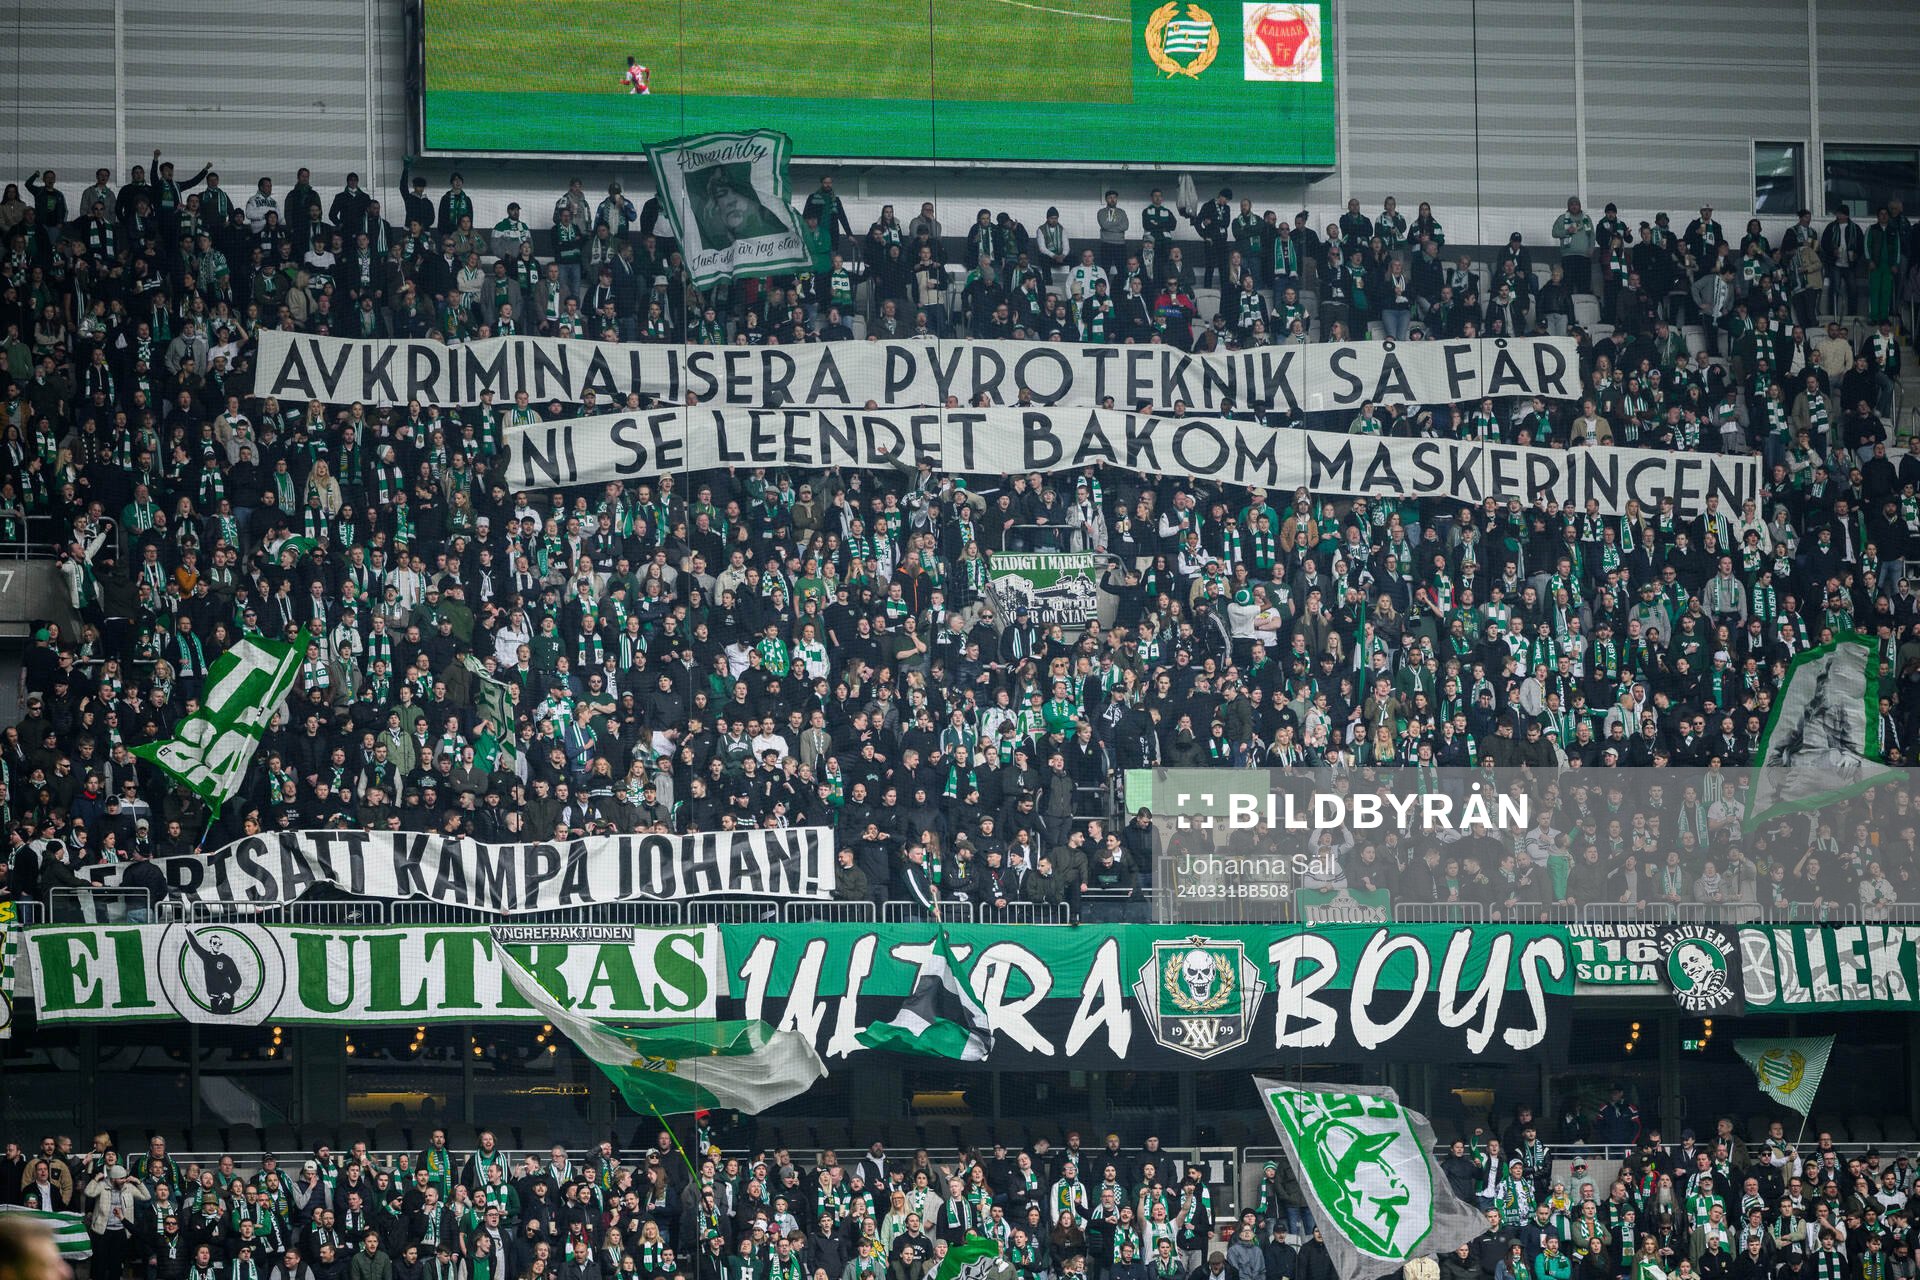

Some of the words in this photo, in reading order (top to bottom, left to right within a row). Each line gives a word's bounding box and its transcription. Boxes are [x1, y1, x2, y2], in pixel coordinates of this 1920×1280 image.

[1261, 24, 1304, 36] KALMAR
[756, 241, 774, 256] jag
[884, 345, 1298, 410] PYROTEKNIK
[1330, 342, 1416, 403] SÅ
[1443, 338, 1566, 399] FÅR
[521, 426, 578, 487] NI
[614, 412, 684, 474] SE
[718, 409, 986, 470] LEENDET
[1023, 409, 1277, 486] BAKOM
[990, 555, 1037, 571] STADIGT
[1040, 556, 1046, 570] I
[1048, 554, 1094, 570] MARKEN
[1042, 610, 1058, 623] OM
[90, 831, 370, 920] FRTSATT
[615, 828, 820, 900] JOHAN!
[494, 926, 632, 939] YNGREFRAKTIONEN
[1660, 925, 1734, 956] SPJUVERN
[1572, 939, 1658, 962] 116
[290, 931, 708, 1014] ULTRAS
[1576, 963, 1659, 981] SOFIA
[1171, 1027, 1183, 1036] 19
[1220, 1026, 1234, 1035] 99
